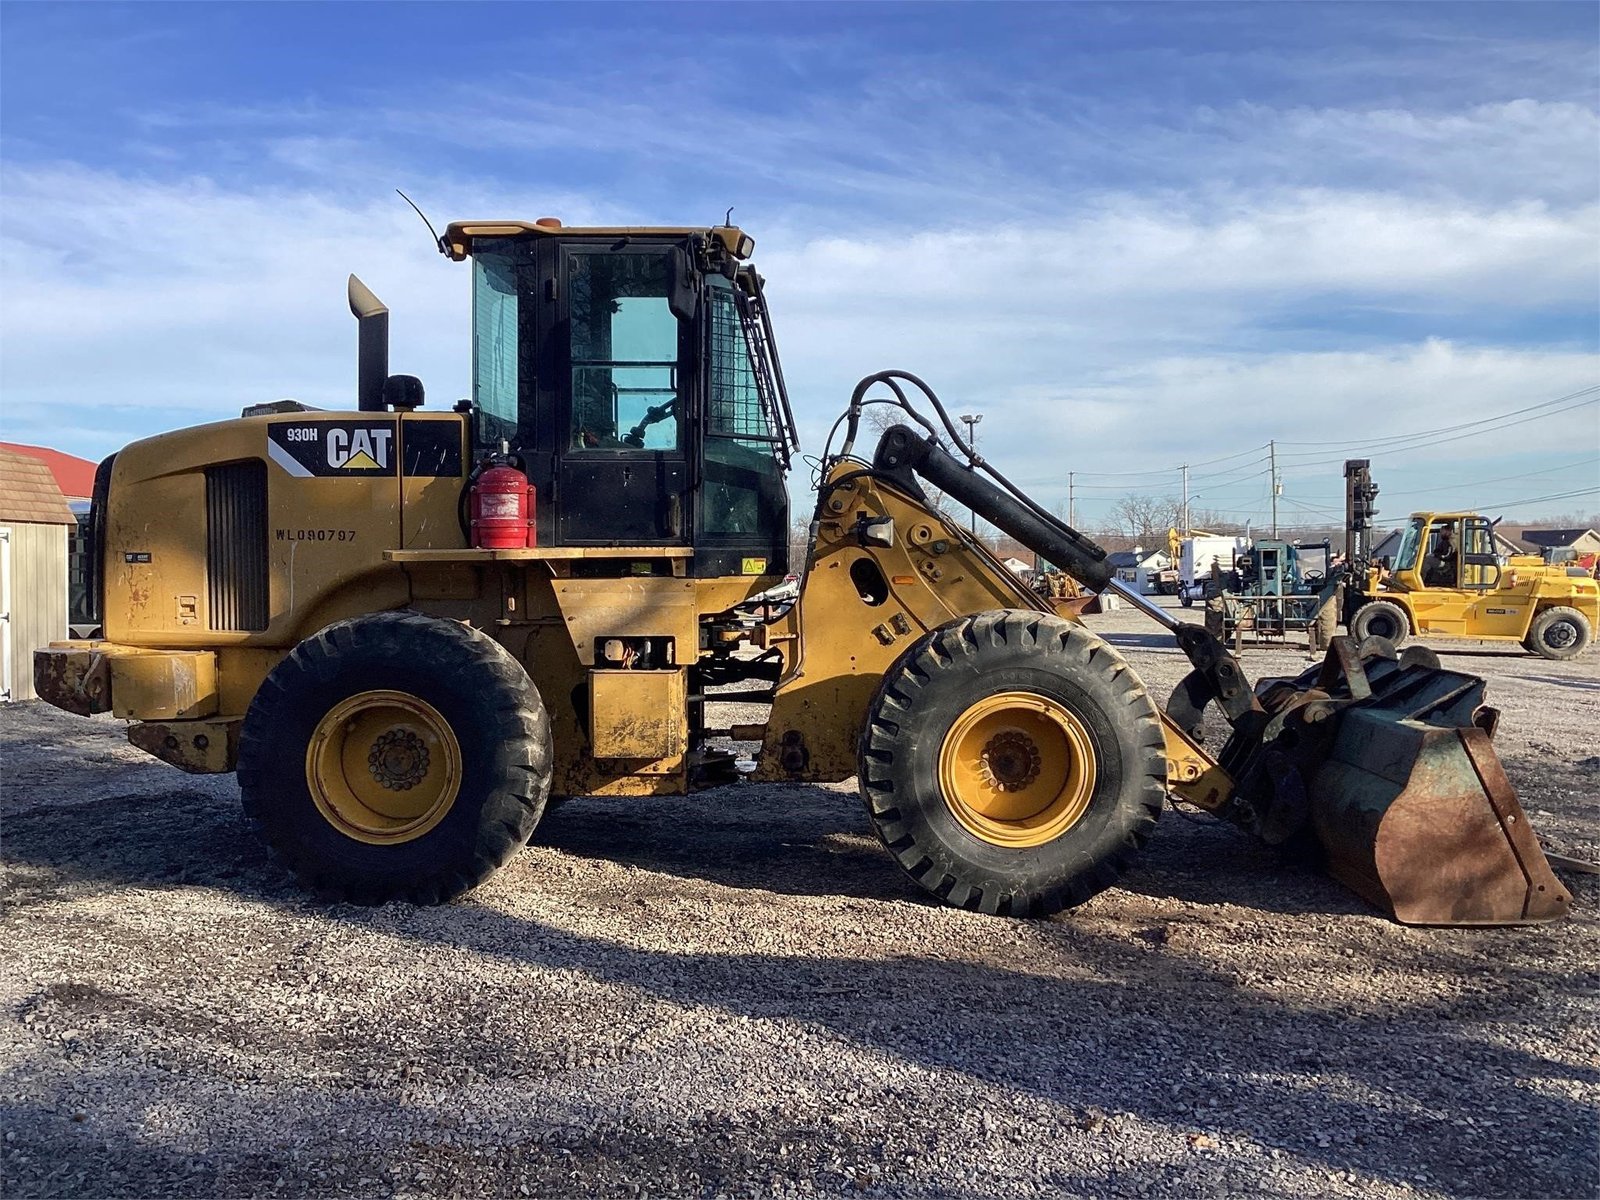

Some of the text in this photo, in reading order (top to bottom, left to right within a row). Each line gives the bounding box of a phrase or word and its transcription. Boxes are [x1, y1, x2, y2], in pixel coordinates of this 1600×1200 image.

[287, 428, 318, 441] 930H
[327, 428, 391, 468] CAT
[275, 529, 356, 541] WL090797
